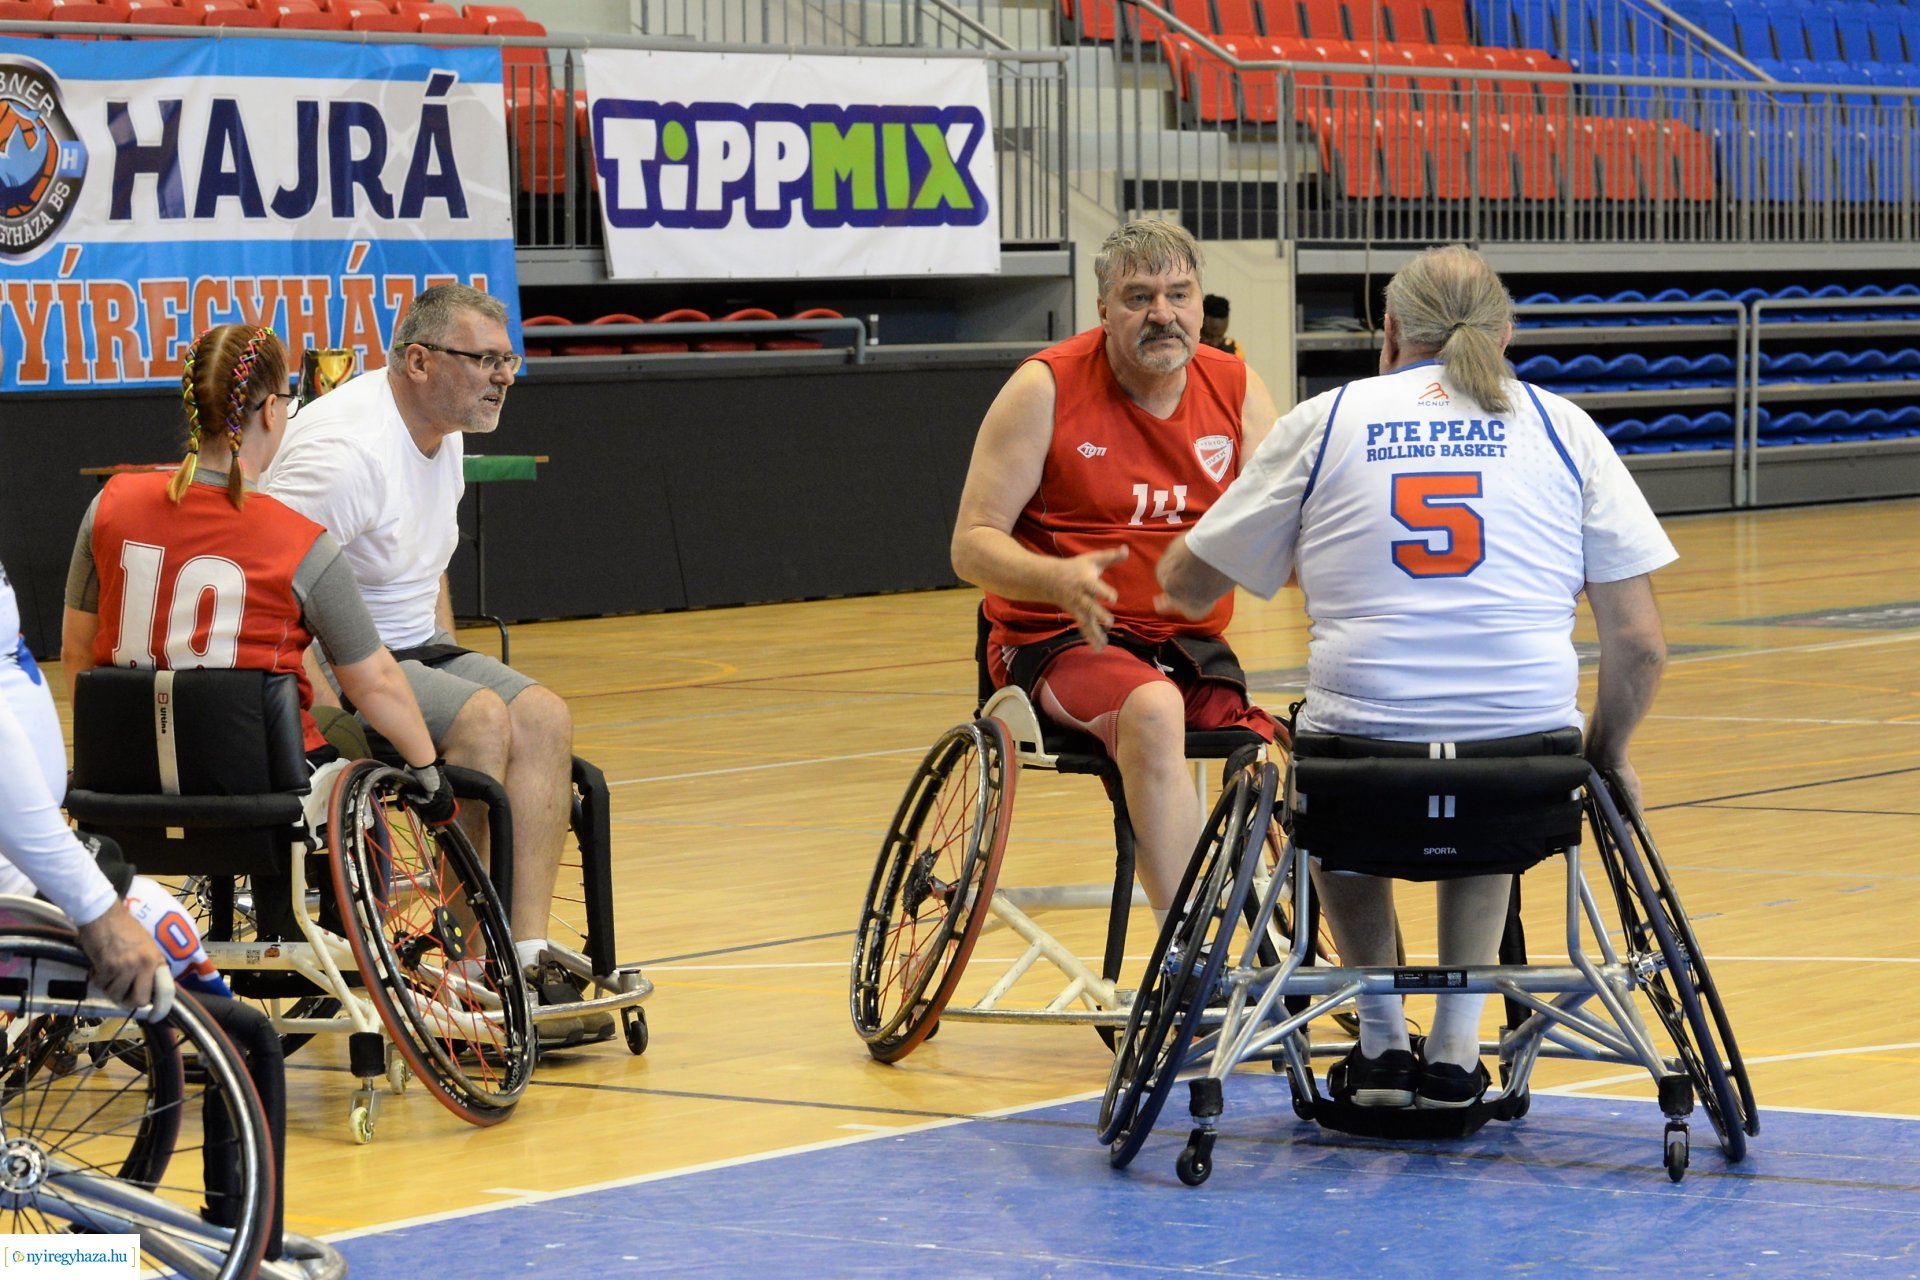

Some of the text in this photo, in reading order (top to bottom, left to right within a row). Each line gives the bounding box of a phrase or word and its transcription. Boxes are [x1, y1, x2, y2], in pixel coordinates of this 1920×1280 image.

[61, 148, 78, 170] H
[106, 74, 470, 220] HAJRÁ
[48, 182, 70, 212] BS
[1367, 420, 1505, 446] PTE PEAC
[1366, 444, 1507, 462] ROLLING BASKET
[1128, 484, 1187, 526] 14
[1391, 472, 1486, 579] 5
[112, 540, 246, 670] 10
[1423, 847, 1457, 855] SPORTA
